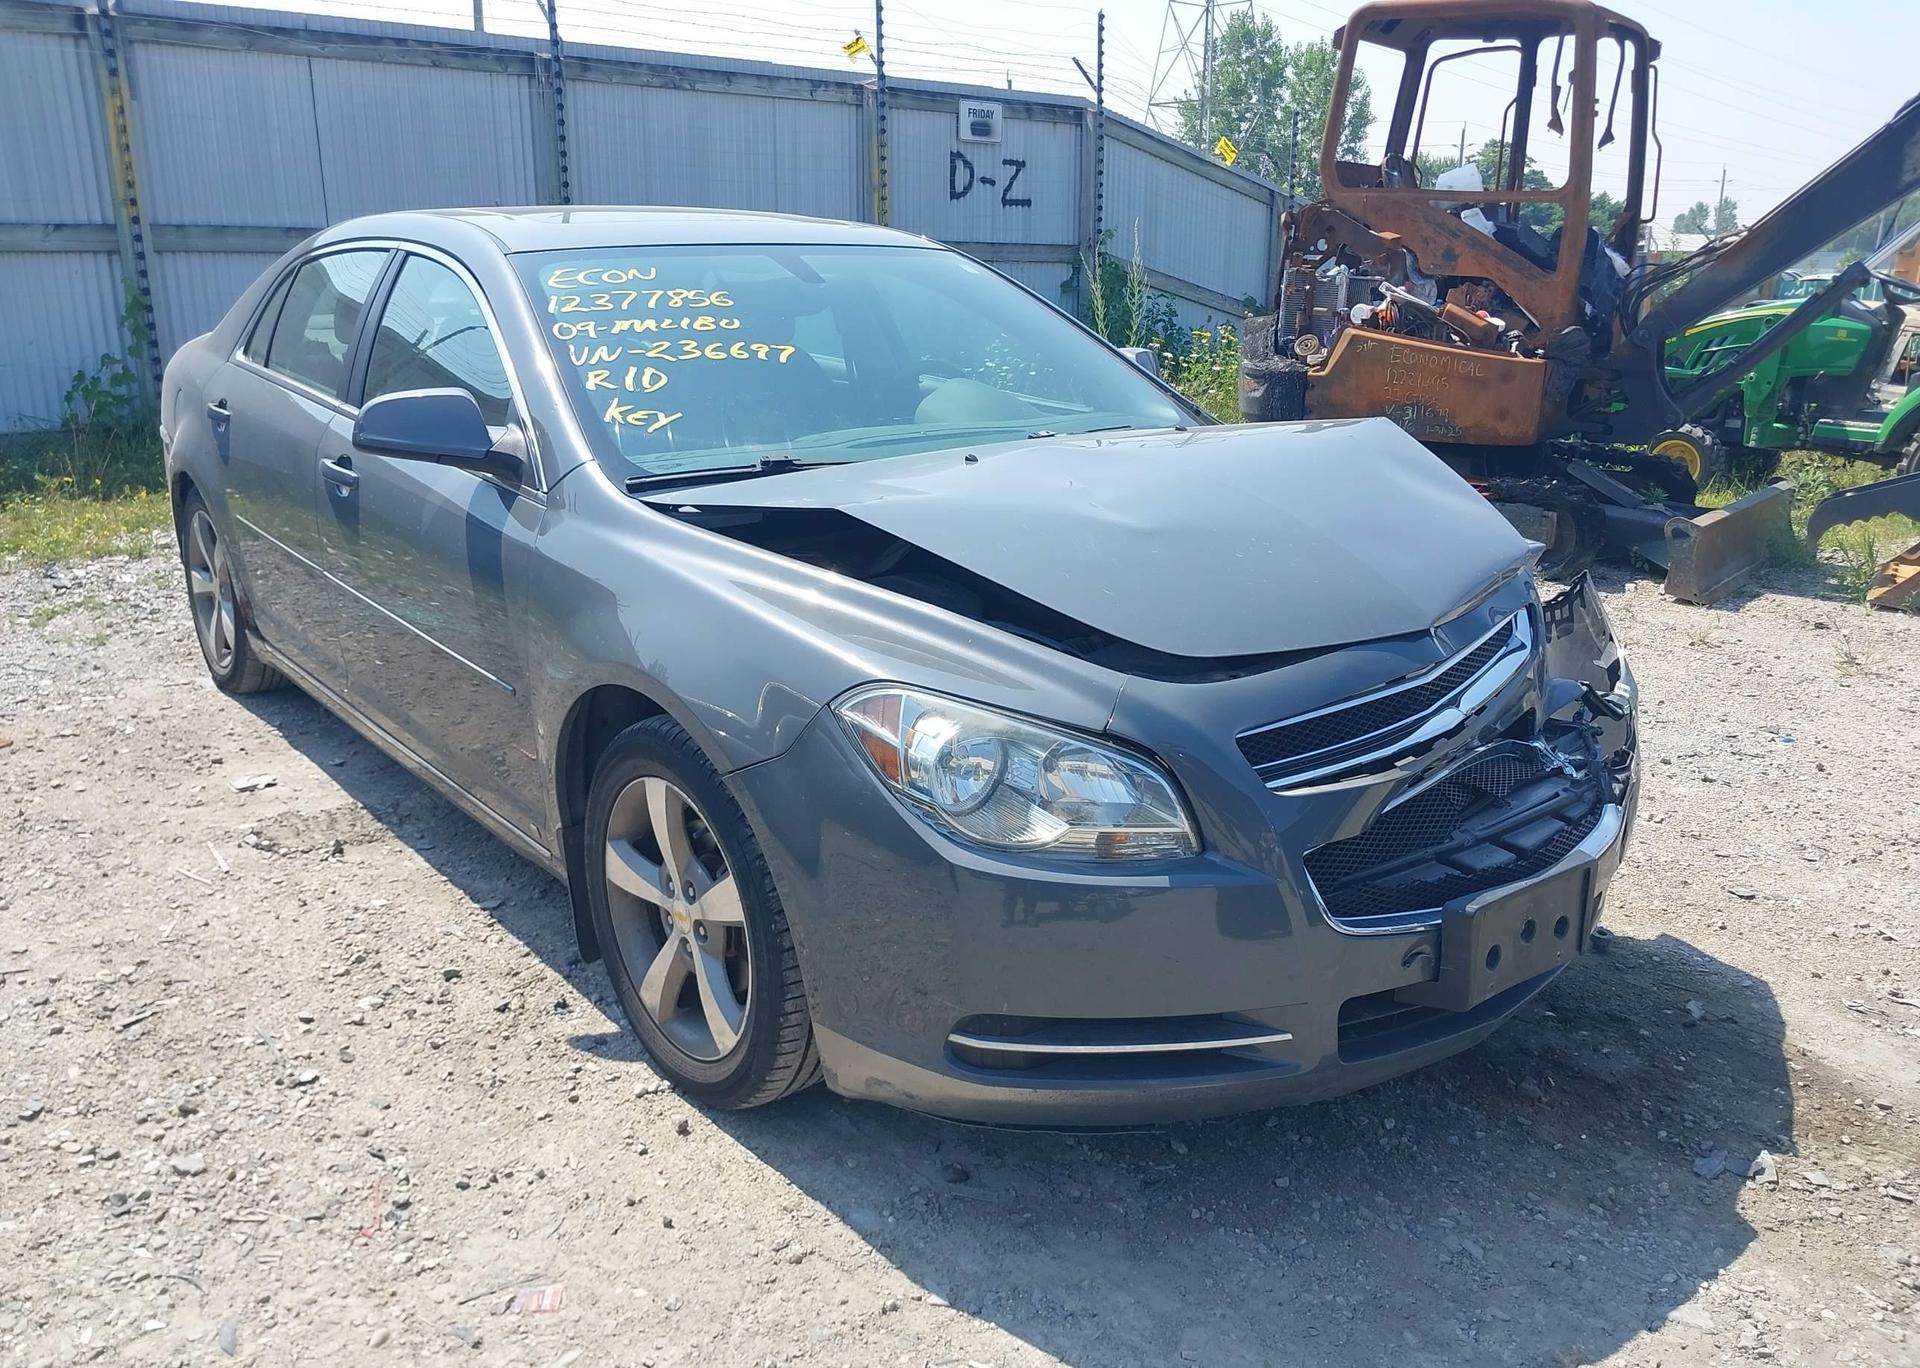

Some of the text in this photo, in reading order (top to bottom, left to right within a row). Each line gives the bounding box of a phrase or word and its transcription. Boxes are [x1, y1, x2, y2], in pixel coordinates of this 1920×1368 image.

[967, 107, 995, 120] FRIDAY
[949, 149, 1032, 208] D-Z
[547, 266, 657, 288] ECON
[547, 288, 735, 315] 12377856
[1389, 344, 1487, 377] ECONOMICAL
[603, 397, 684, 434] KEY
